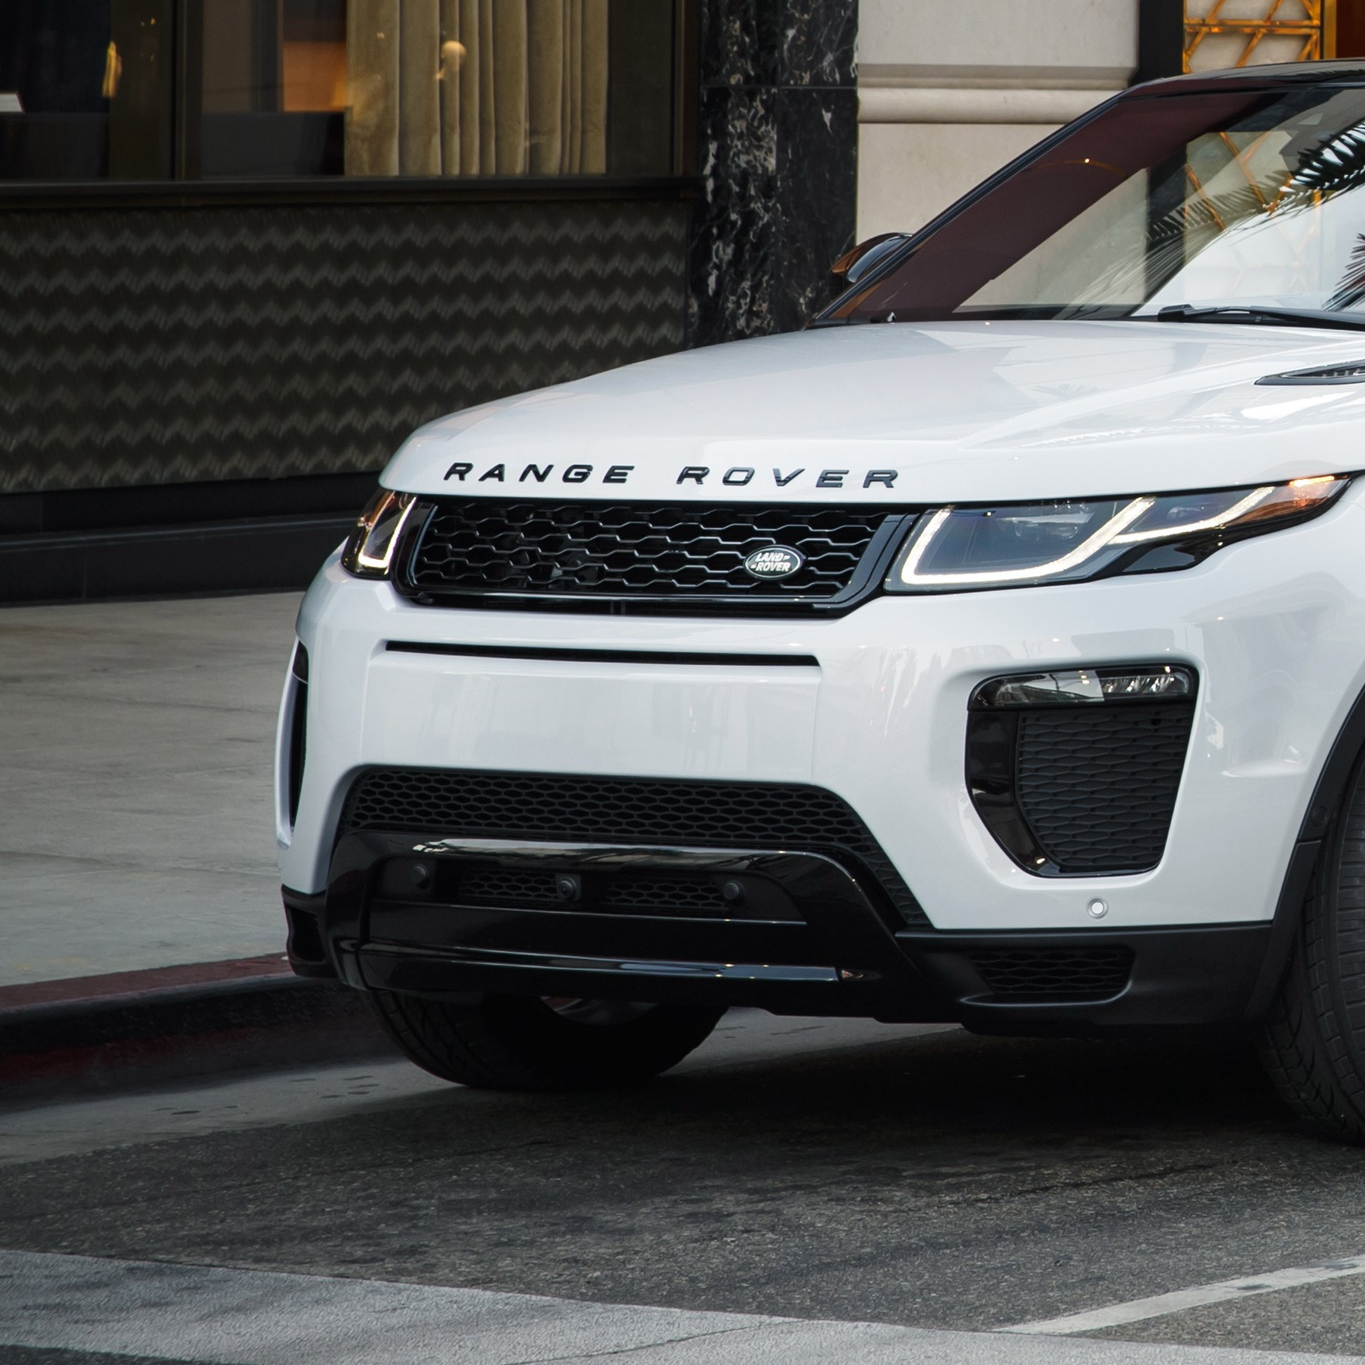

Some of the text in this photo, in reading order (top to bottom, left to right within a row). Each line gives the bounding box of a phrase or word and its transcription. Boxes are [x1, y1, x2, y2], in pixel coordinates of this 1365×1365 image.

[443, 462, 900, 489] RANGE ROVER
[755, 552, 785, 562] LAND
[755, 561, 791, 572] ROVER
